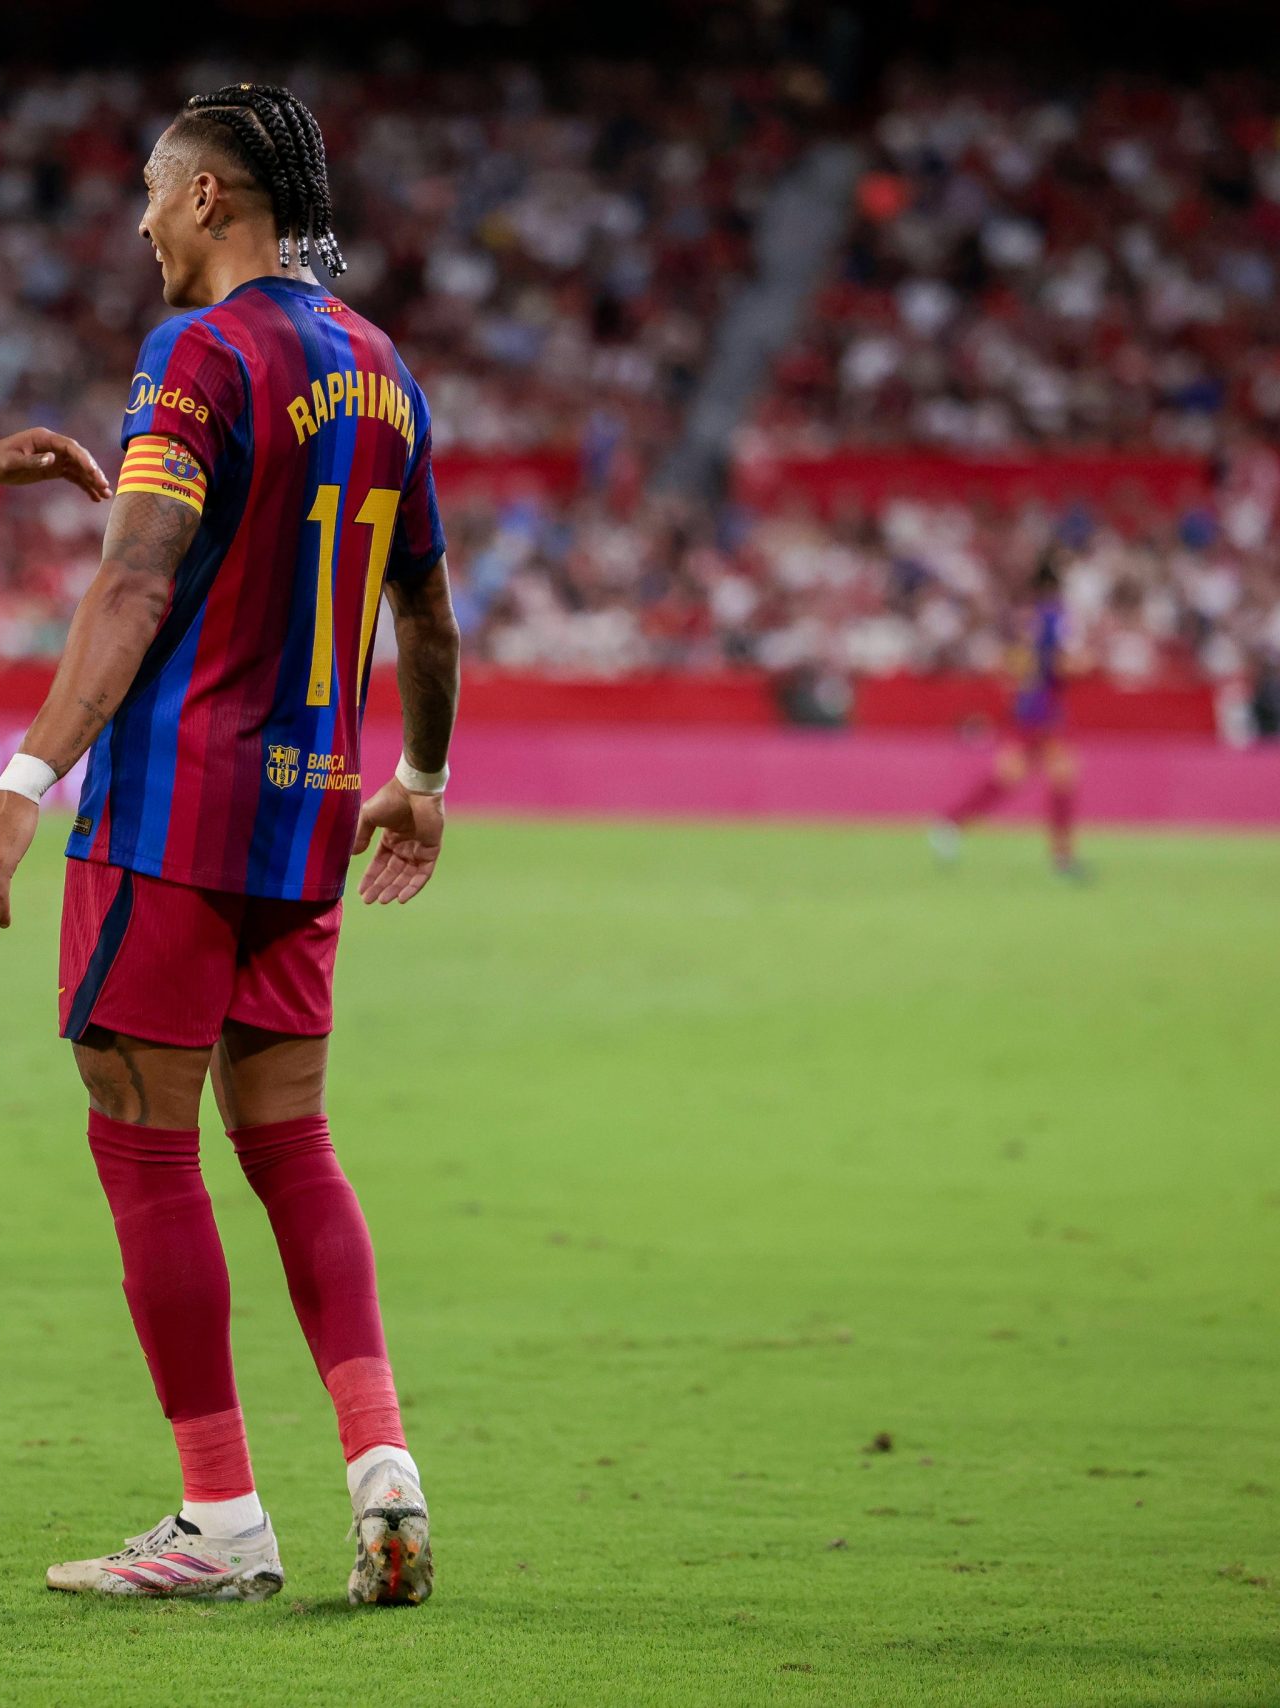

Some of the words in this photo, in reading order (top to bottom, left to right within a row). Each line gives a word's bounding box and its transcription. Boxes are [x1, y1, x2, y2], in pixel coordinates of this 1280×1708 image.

[126, 372, 209, 424] Midea
[306, 484, 401, 707] 11
[307, 753, 344, 773] BARÇA
